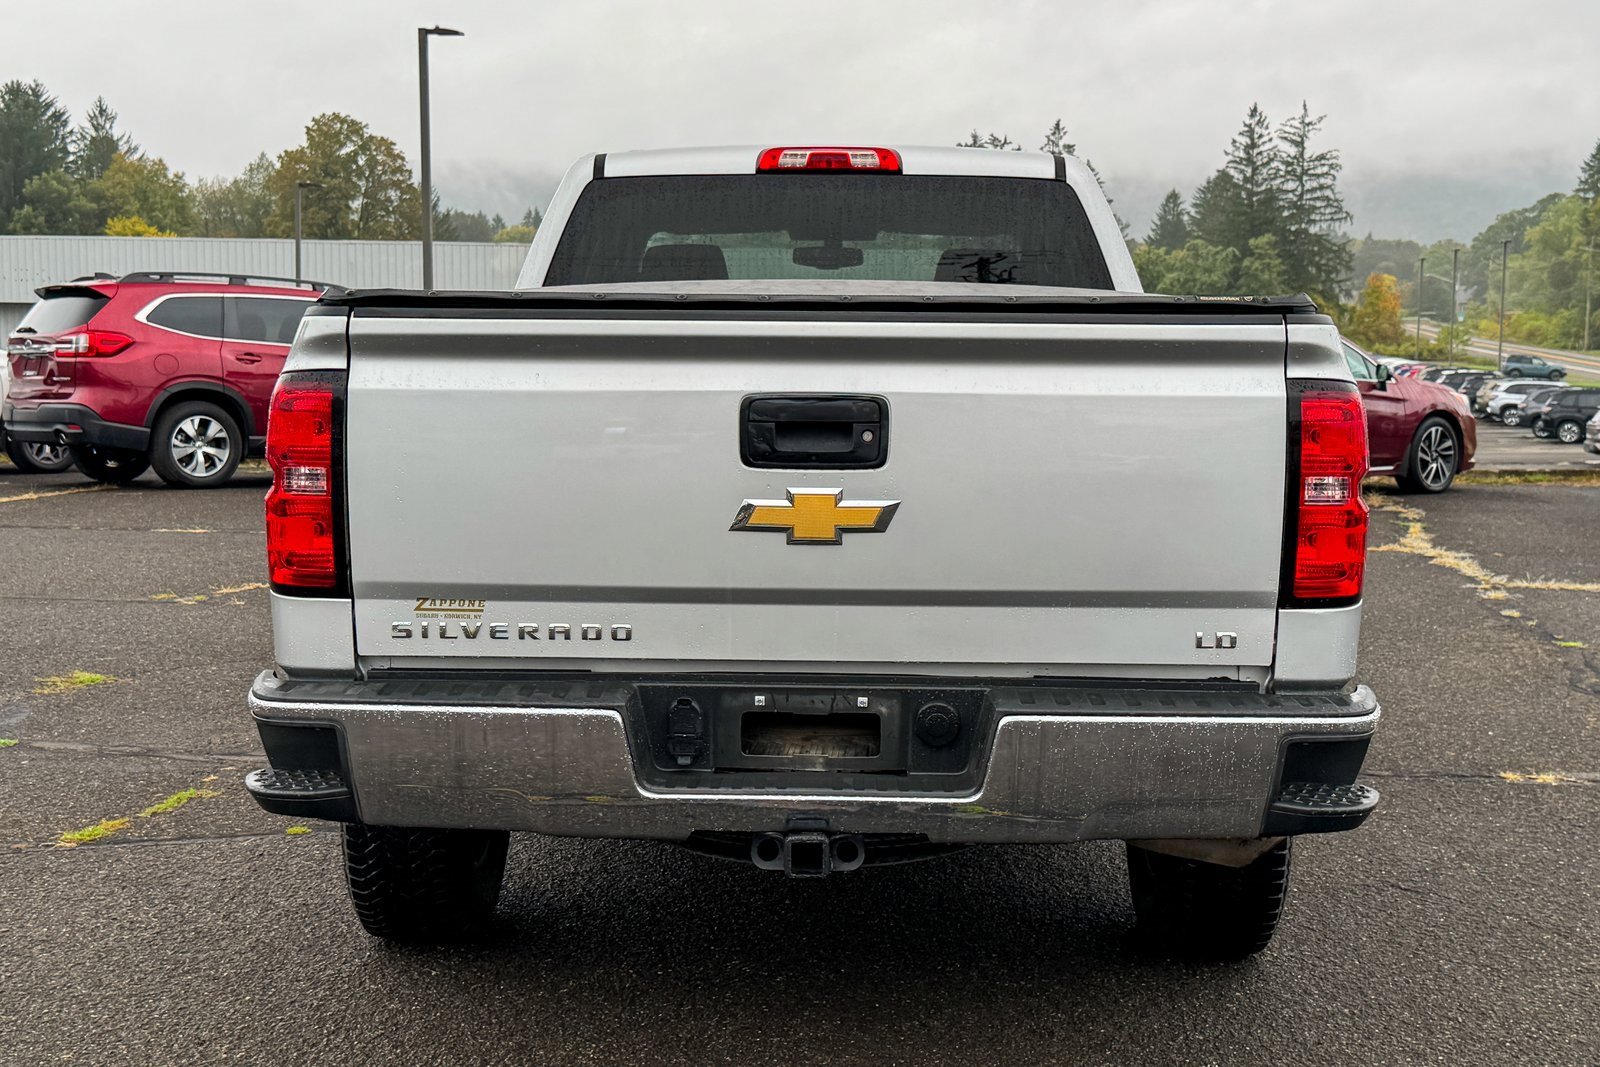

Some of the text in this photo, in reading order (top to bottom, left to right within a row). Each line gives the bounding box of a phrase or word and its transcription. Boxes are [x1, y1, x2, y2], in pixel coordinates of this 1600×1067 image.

[414, 597, 486, 612] ZAPPONE
[391, 621, 633, 641] SILVERADO
[1195, 631, 1238, 649] LD
